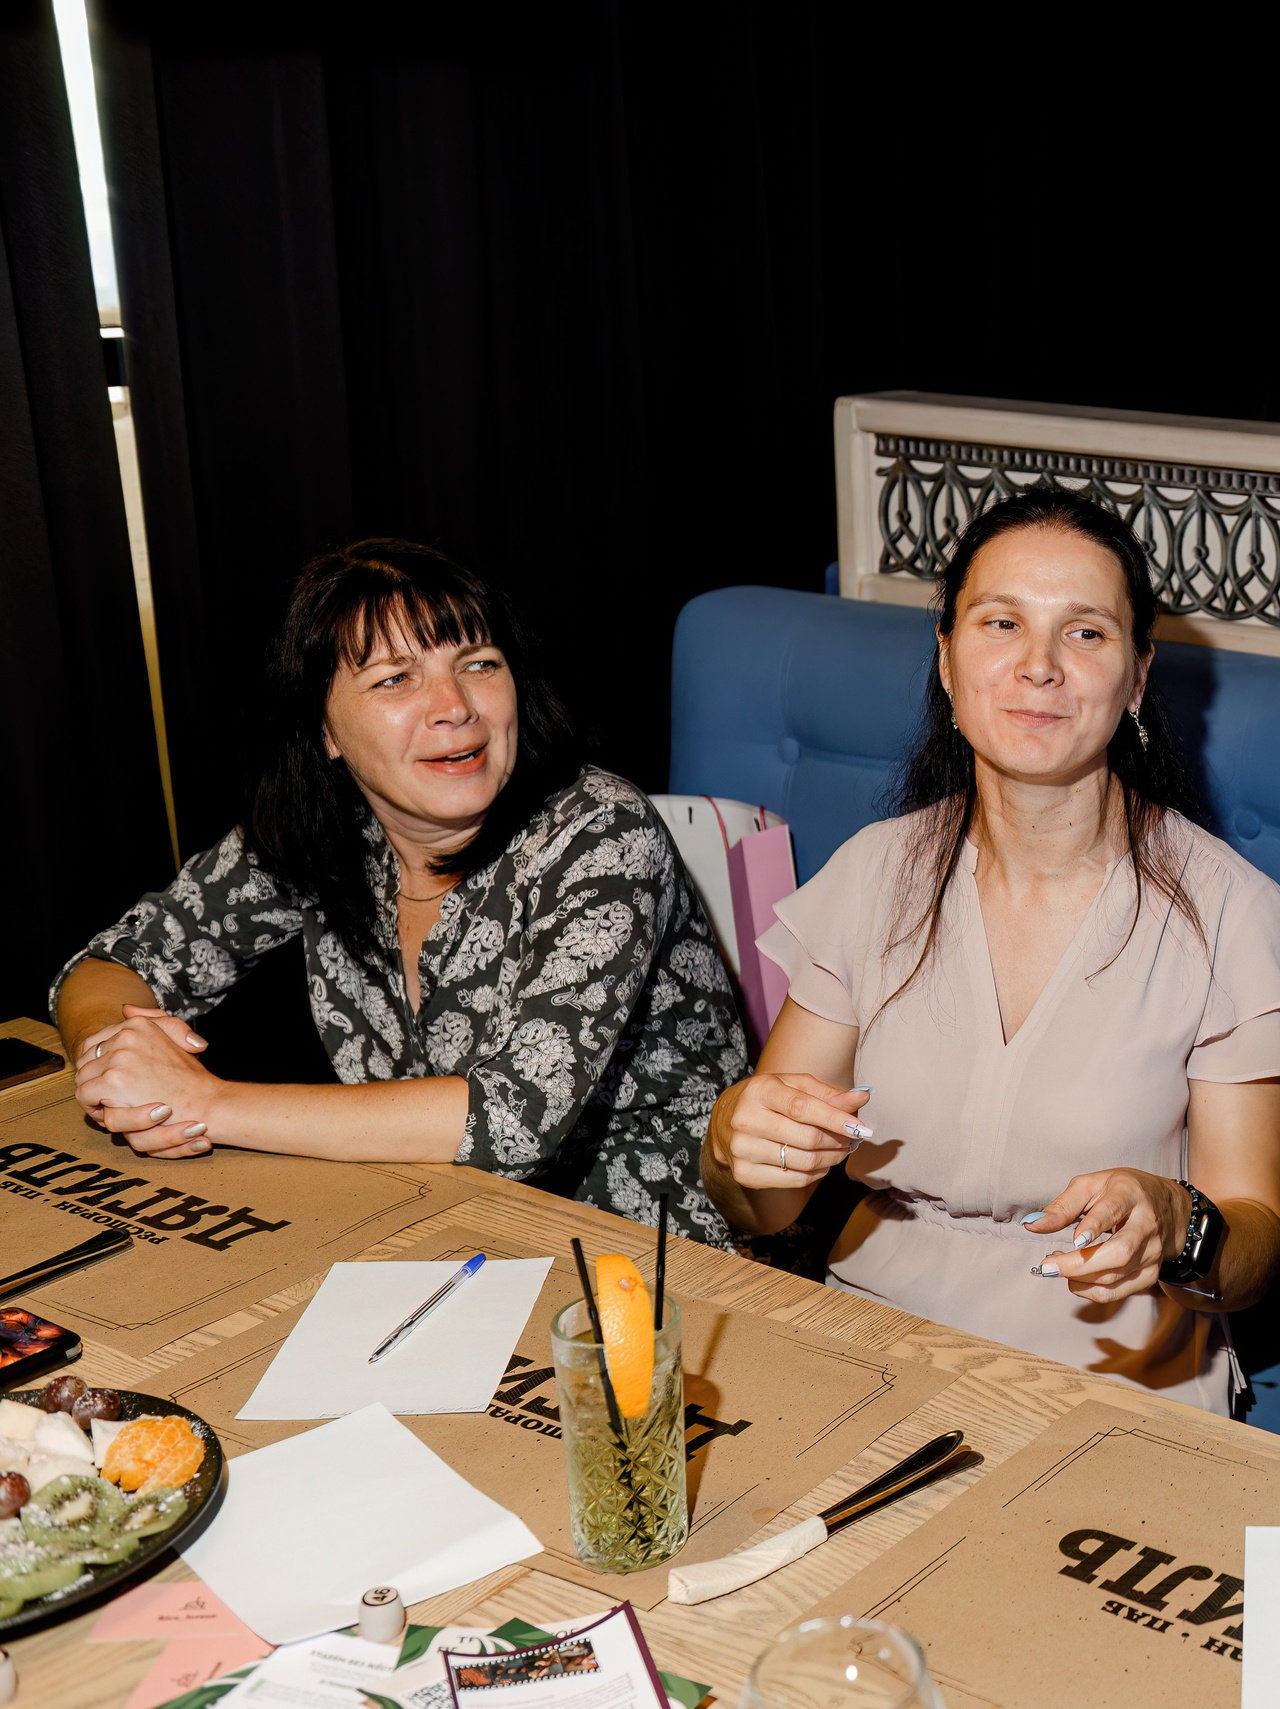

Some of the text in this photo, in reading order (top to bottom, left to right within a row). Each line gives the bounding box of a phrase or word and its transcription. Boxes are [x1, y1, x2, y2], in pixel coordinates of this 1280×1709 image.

[0, 1180, 45, 1200] ПАБ
[0, 1142, 292, 1252] ДЯГИЛЬ
[1101, 1600, 1174, 1634] ПАБ
